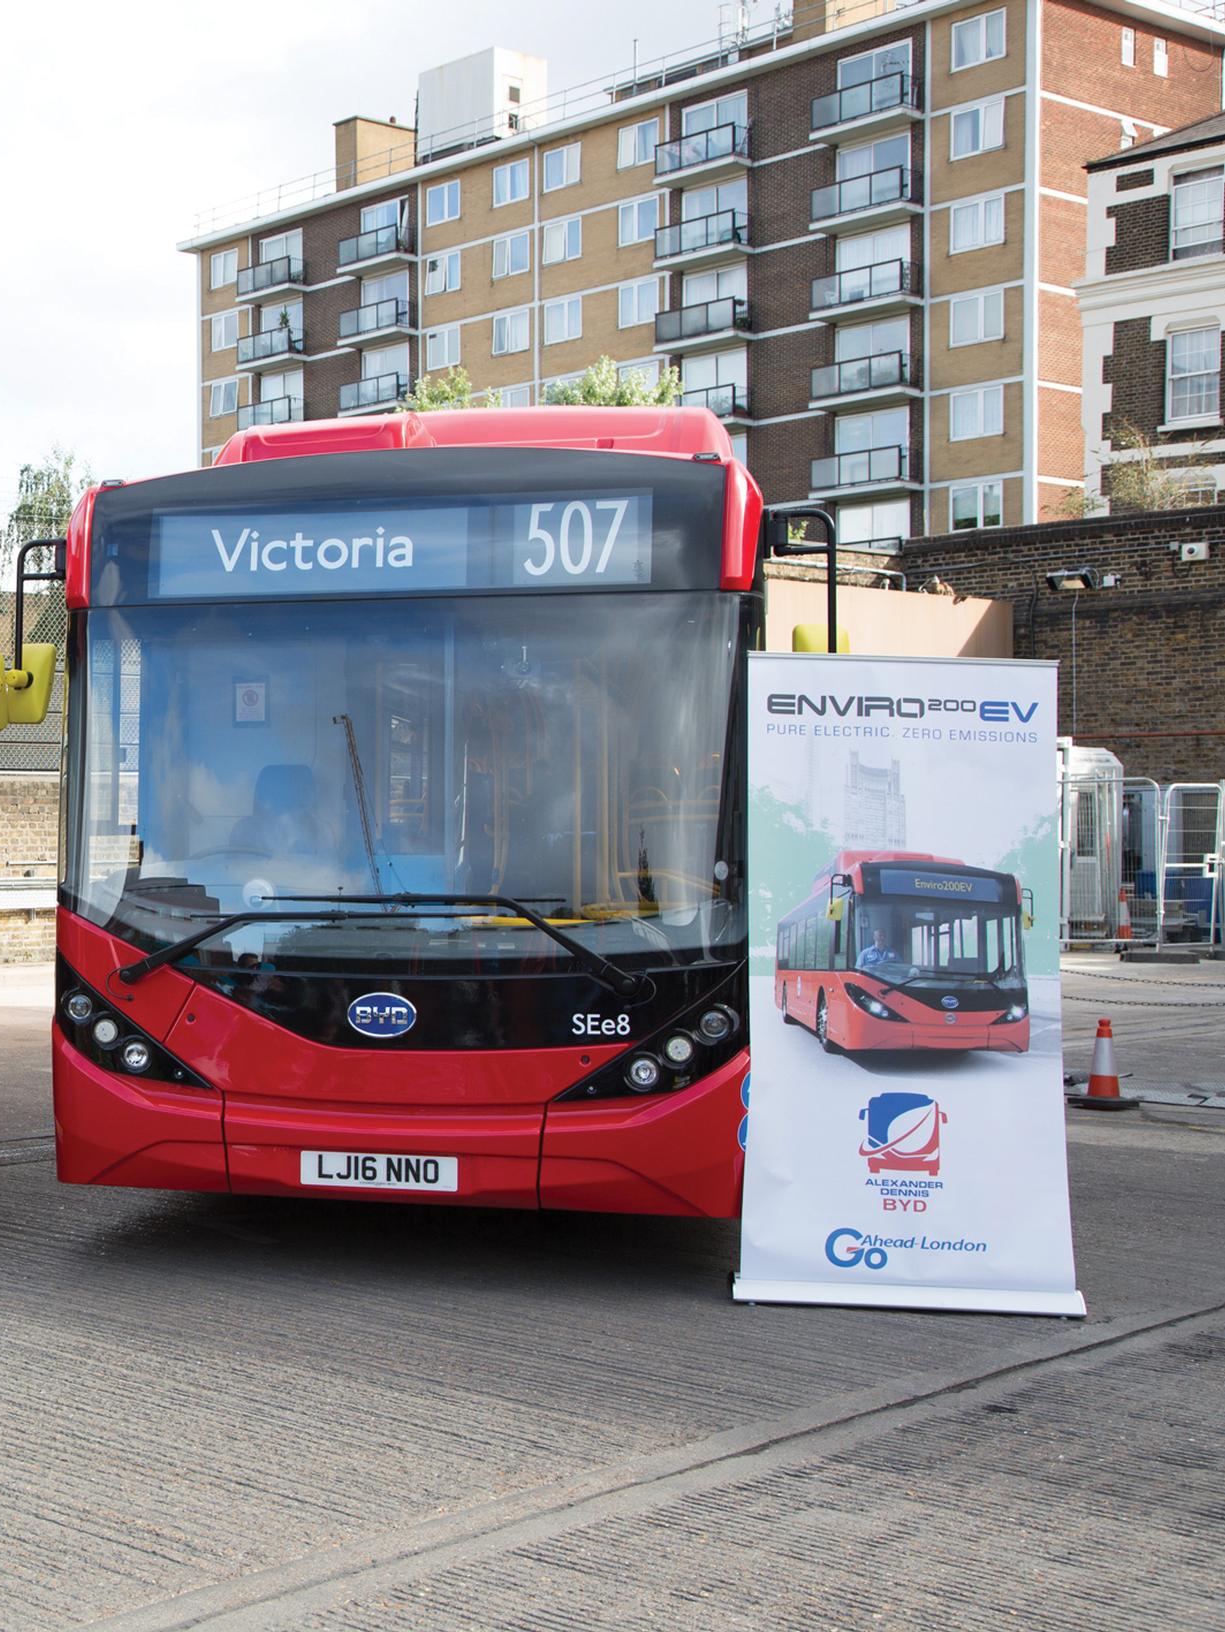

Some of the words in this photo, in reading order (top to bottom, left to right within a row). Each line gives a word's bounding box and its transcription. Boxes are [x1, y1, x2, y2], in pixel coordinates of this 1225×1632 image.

[211, 526, 413, 572] Victoria
[523, 500, 629, 576] 507
[766, 723, 807, 736] PURE
[814, 725, 895, 738] ELECTRIC.
[902, 728, 942, 740] ZERO
[949, 730, 1038, 743] EMISSIONS
[914, 879, 973, 892] Enviro200EV
[355, 1006, 407, 1025] BYD
[572, 1014, 631, 1035] SEe8
[318, 1154, 377, 1181] LJ16
[386, 1157, 439, 1184] NNO
[865, 1178, 943, 1189] ALEXANDER
[880, 1188, 929, 1197] DENNIS
[883, 1198, 927, 1212] BYD
[825, 1227, 888, 1270] Go
